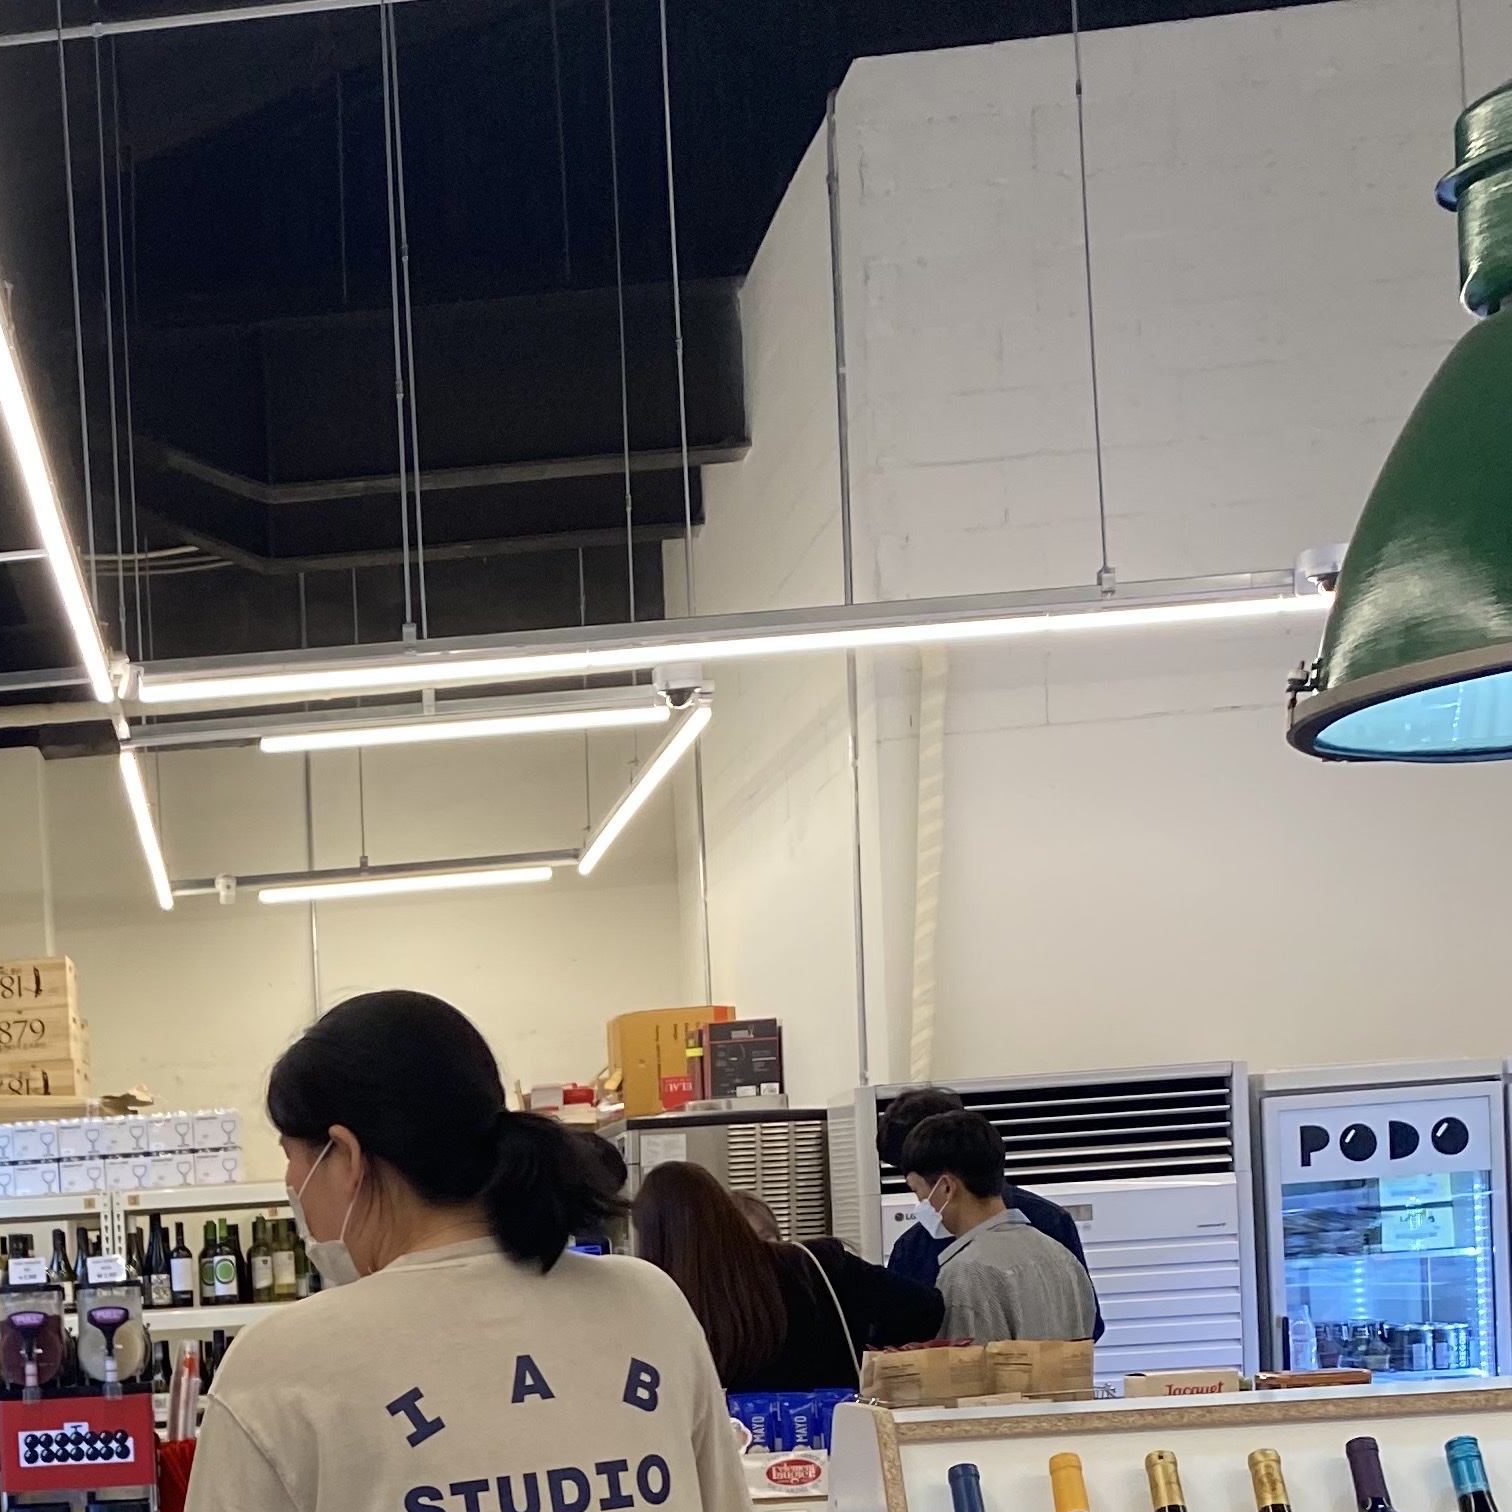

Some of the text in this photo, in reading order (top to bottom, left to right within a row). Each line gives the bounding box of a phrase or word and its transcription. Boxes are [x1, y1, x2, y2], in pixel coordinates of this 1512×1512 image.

[1299, 1116, 1470, 1168] PODO
[752, 1415, 765, 1443] MAYO
[794, 1415, 808, 1443] MAYO
